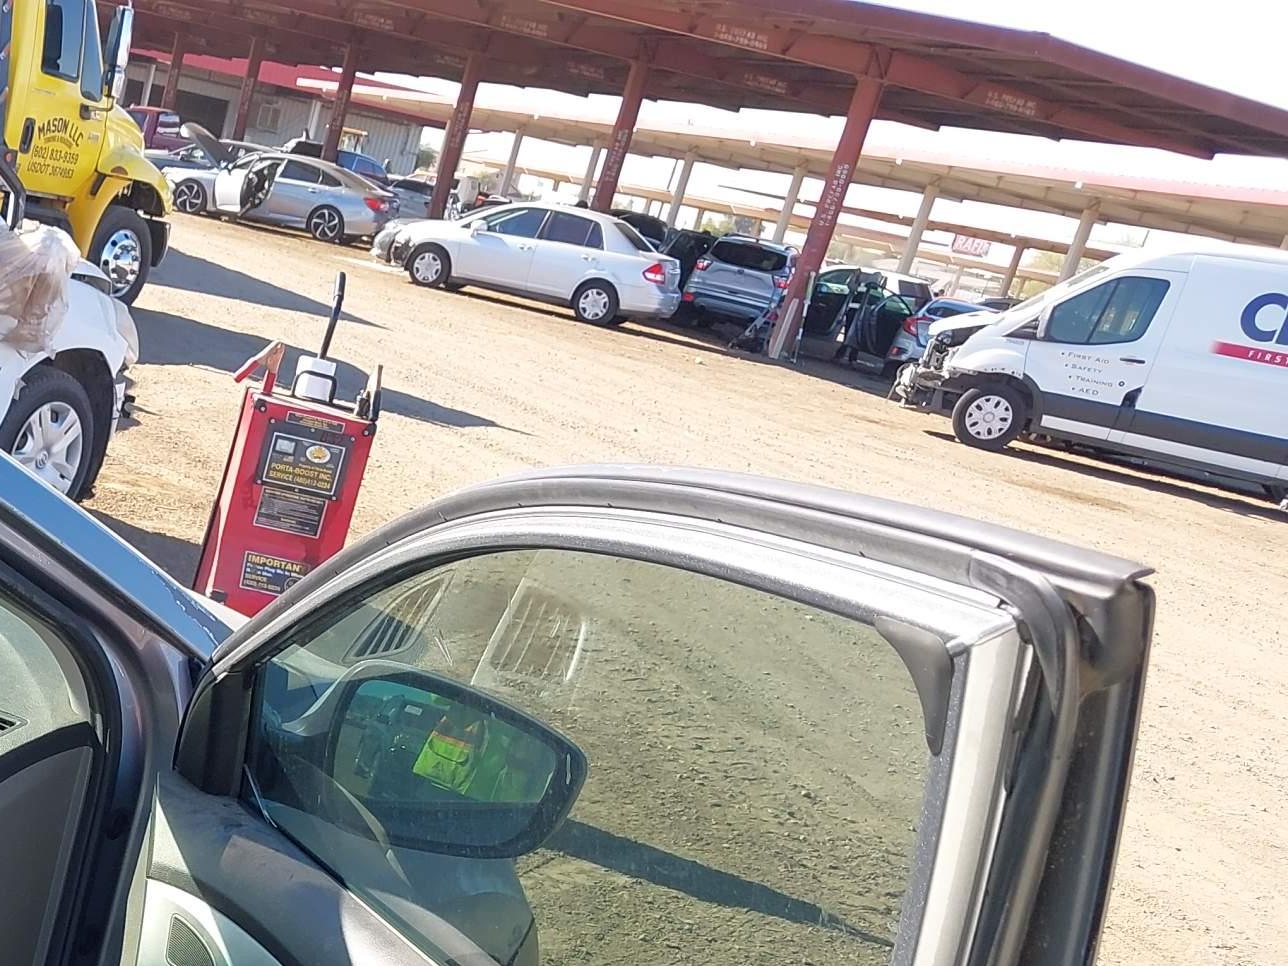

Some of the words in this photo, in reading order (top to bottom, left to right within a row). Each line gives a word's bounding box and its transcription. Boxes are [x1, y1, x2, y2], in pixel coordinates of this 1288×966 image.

[38, 117, 70, 140] MASON
[68, 122, 84, 147] LLC
[27, 160, 50, 174] USDOT
[269, 471, 293, 481] SERVICE
[270, 462, 318, 478] PORTA-BOOST
